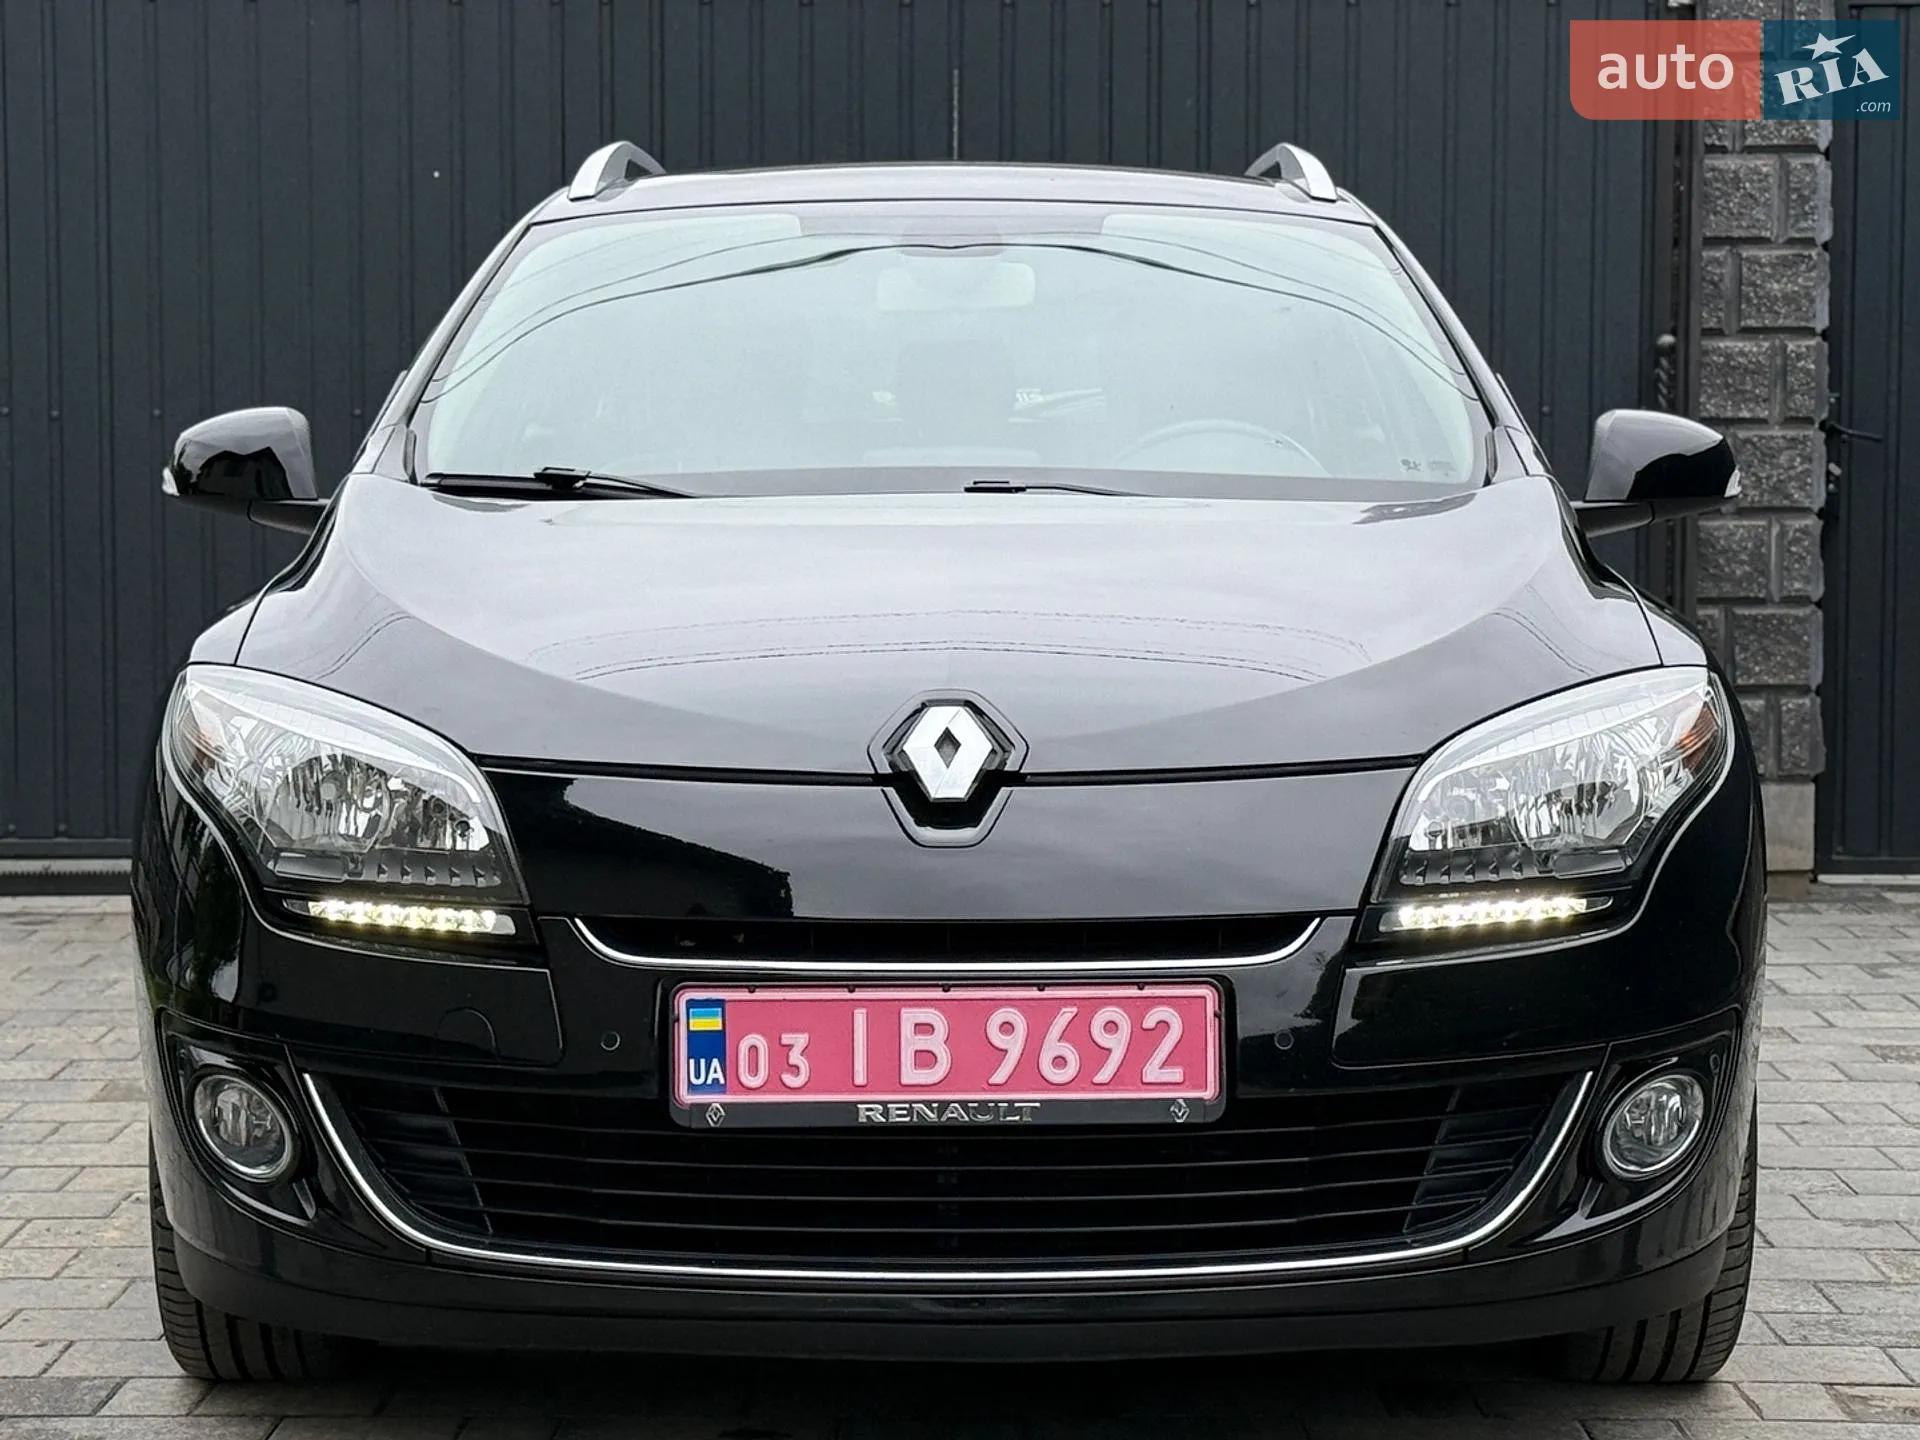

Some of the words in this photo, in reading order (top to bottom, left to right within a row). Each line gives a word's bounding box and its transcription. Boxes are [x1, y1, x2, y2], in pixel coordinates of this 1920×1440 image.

[737, 1032, 811, 1090] 03
[986, 1006, 1186, 1087] 9692
[689, 1058, 726, 1086] UA
[857, 1102, 1041, 1123] RENAULT
